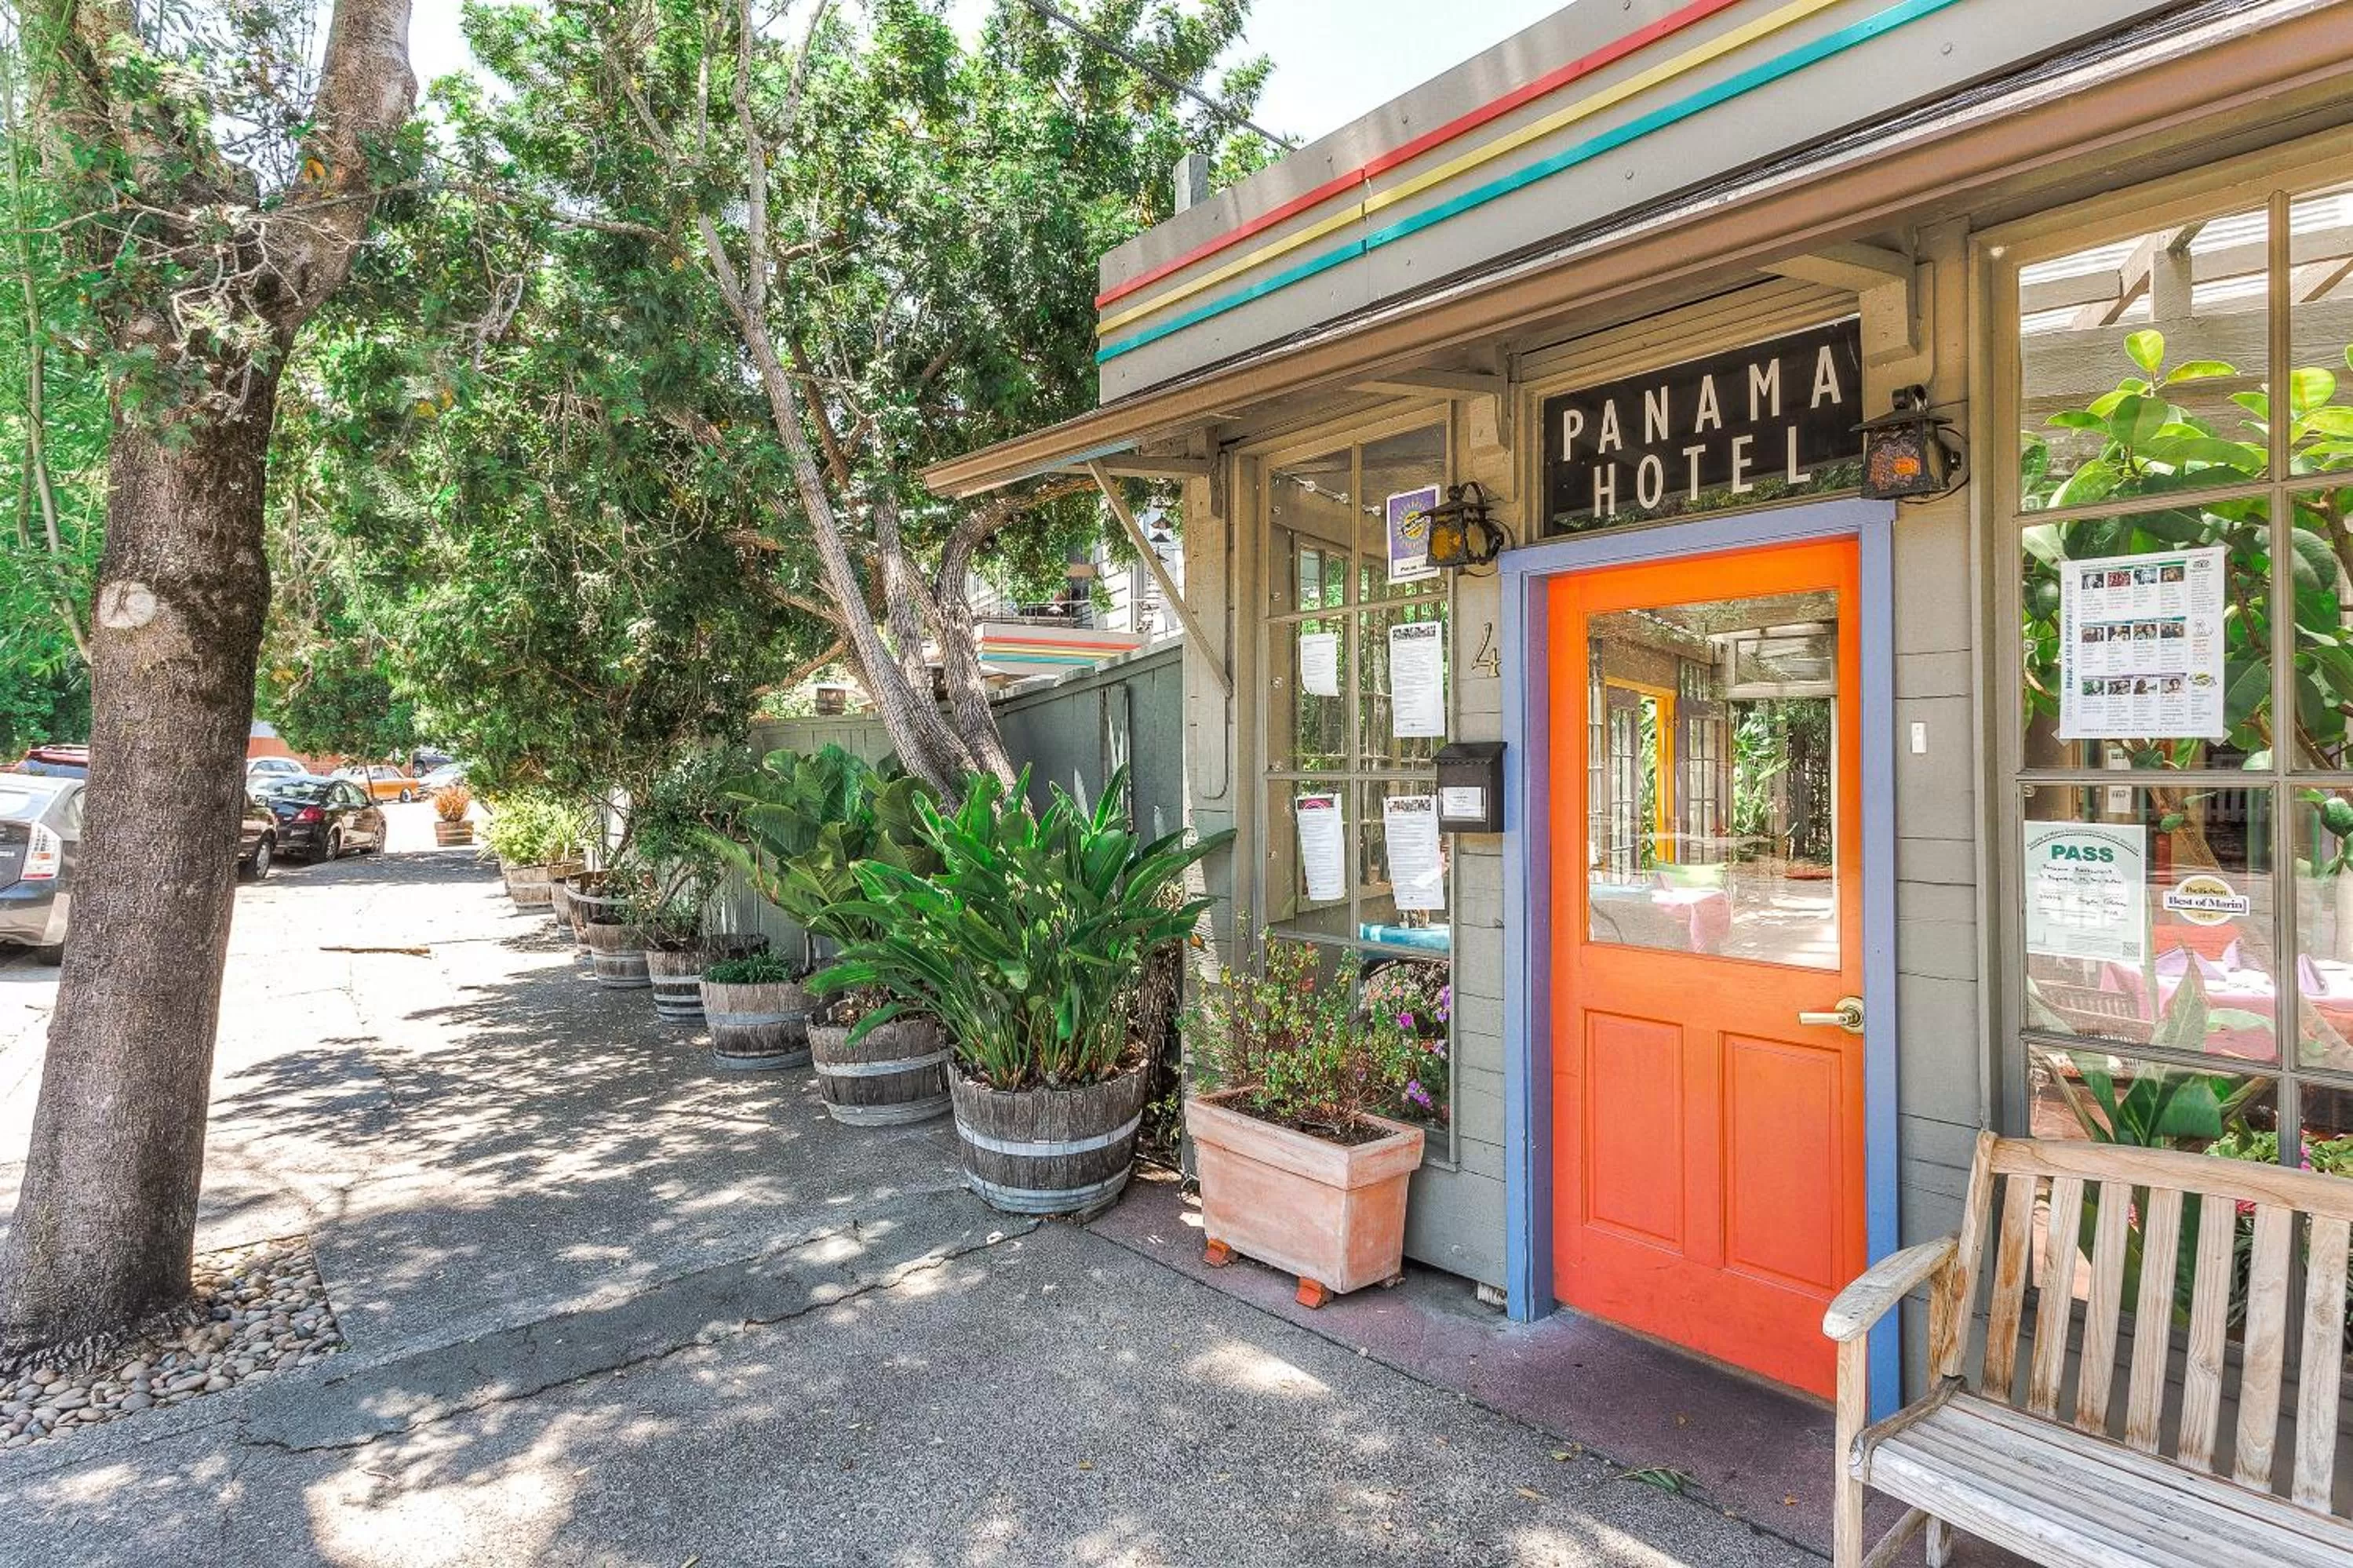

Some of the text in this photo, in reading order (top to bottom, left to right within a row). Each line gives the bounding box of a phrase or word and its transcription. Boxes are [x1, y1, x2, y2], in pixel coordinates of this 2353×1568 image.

[1562, 345, 1842, 461] PANAMA
[1594, 426, 1811, 518] HOTEL
[1471, 622, 1501, 678] 4
[2051, 845, 2114, 863] PASS
[2169, 897, 2242, 909] Best of Marin
